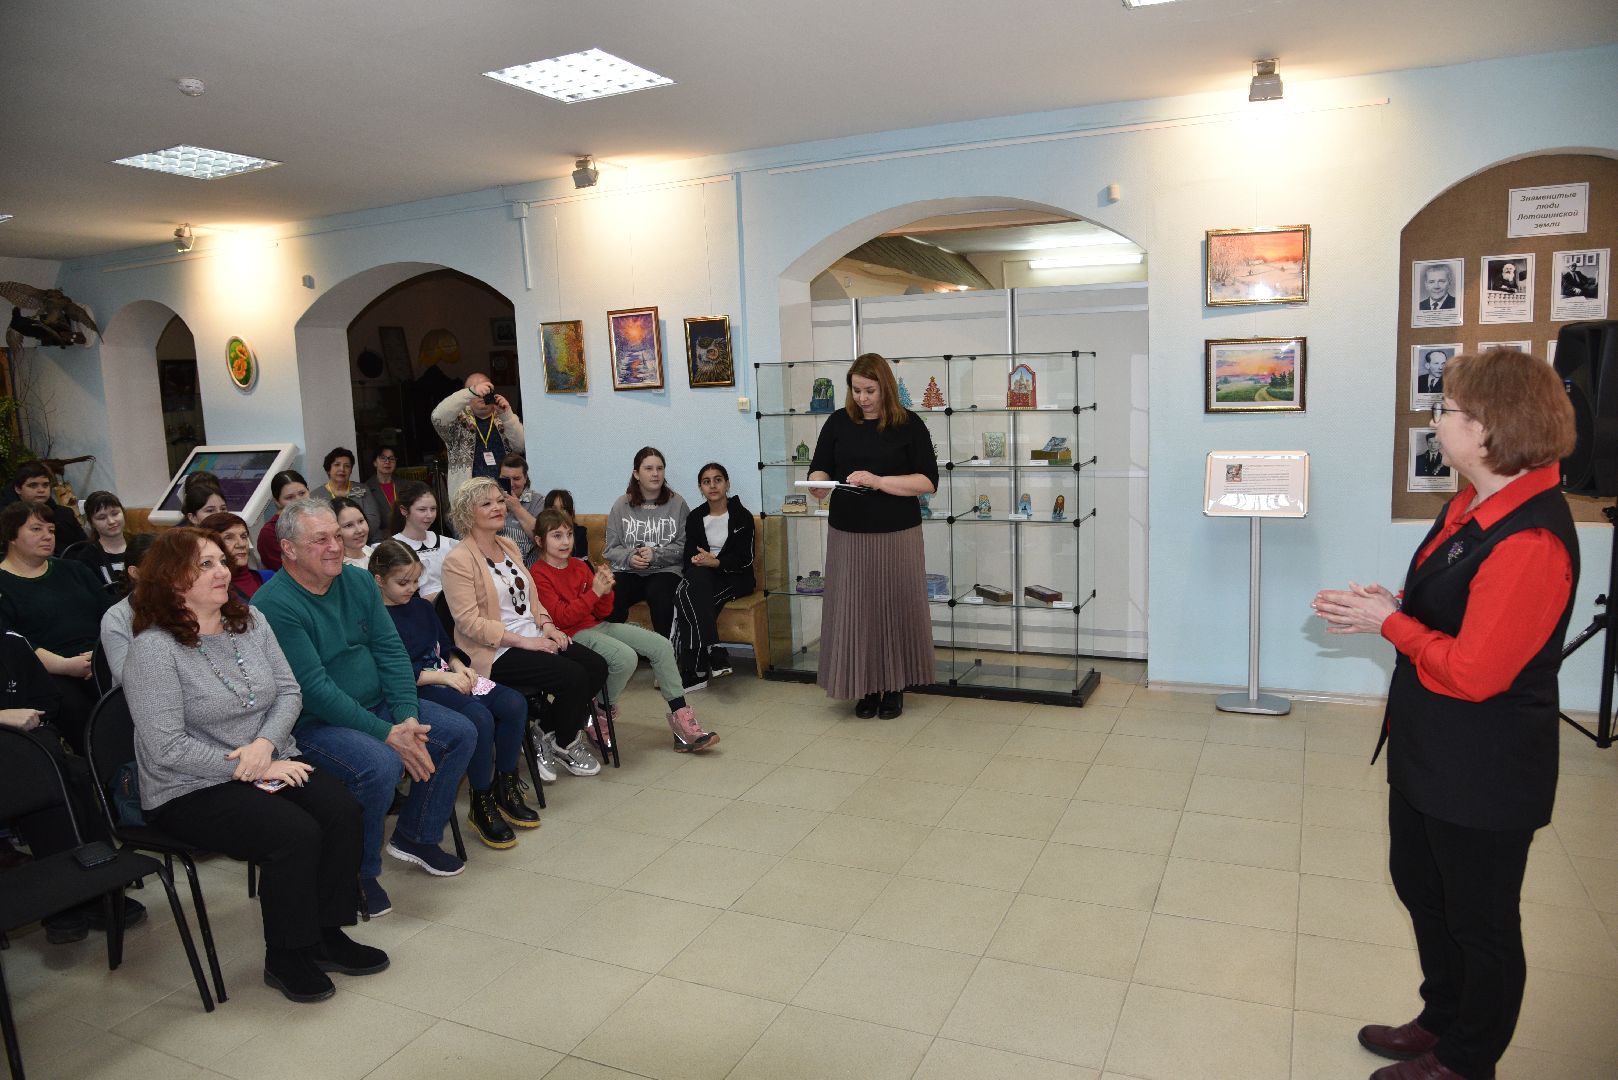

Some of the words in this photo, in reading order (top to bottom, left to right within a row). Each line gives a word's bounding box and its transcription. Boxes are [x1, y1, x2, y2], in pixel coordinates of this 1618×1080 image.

[1520, 192, 1577, 202] Знаменитые
[1536, 202, 1560, 210] люди
[1534, 221, 1561, 229] земли
[622, 514, 677, 545] DREAMER
